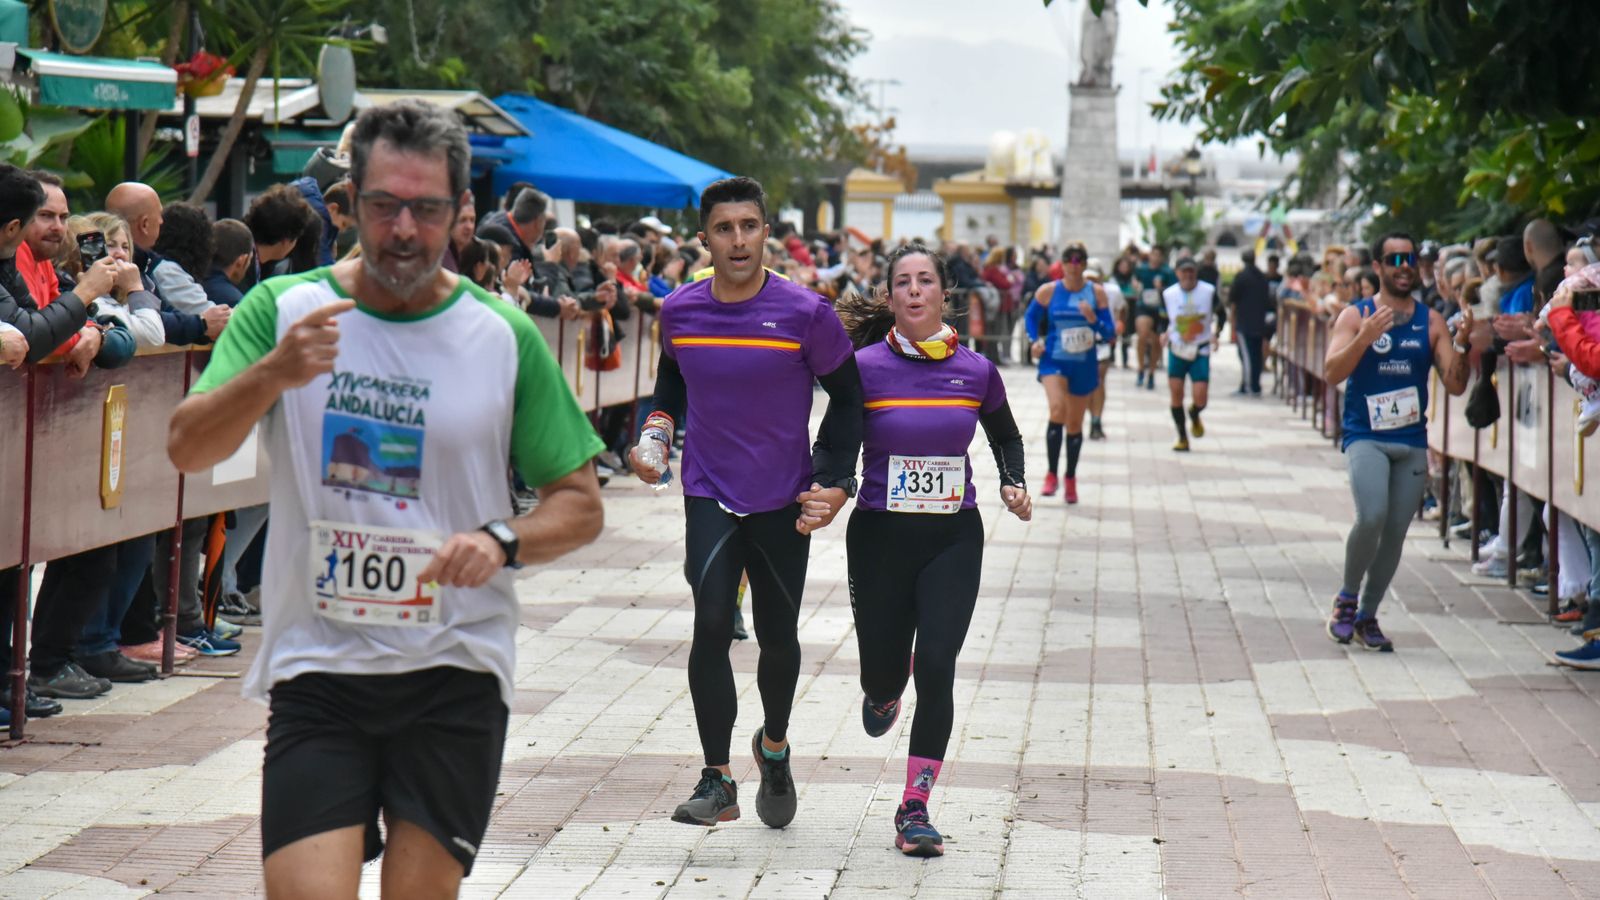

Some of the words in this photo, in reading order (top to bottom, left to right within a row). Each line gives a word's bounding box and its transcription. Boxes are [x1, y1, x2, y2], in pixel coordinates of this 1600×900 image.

[327, 369, 360, 393] XIV
[360, 375, 430, 401] CARRERA
[325, 392, 425, 427] ANDALUCÍA
[1390, 400, 1399, 416] 4
[902, 459, 927, 471] XIV
[907, 471, 944, 494] 331
[332, 529, 371, 550] XIV
[372, 534, 415, 544] CARRERA
[371, 544, 388, 553] DEL
[341, 550, 405, 592] 160
